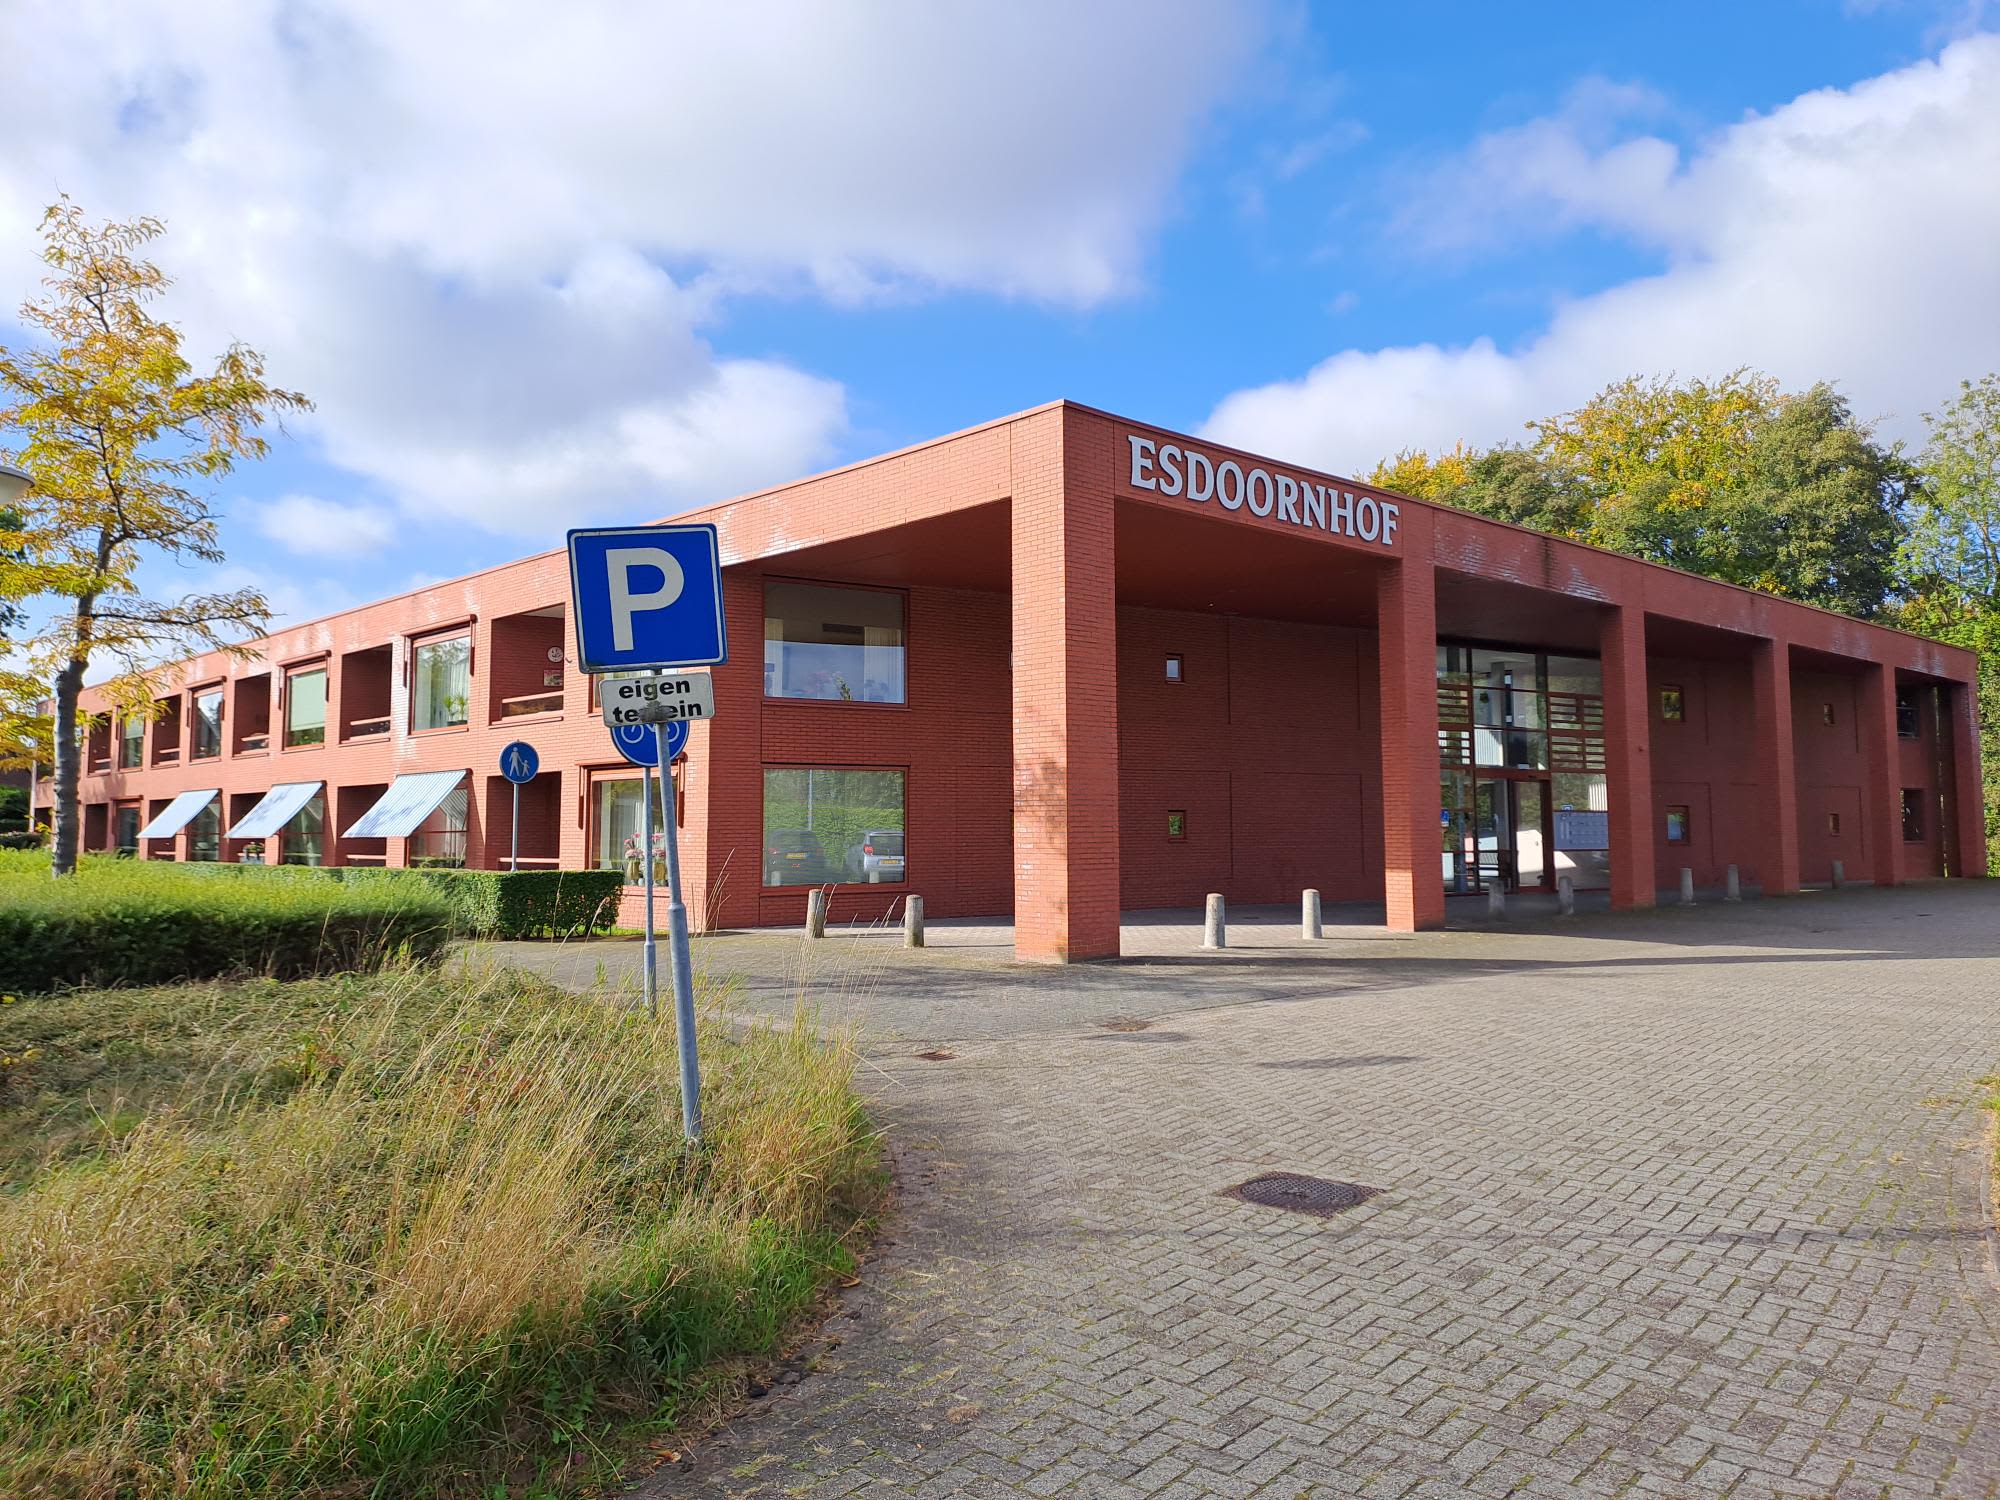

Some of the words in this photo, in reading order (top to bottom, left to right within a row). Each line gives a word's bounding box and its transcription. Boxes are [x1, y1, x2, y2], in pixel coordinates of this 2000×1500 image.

[1128, 435, 1400, 545] ESDOORNHOF
[606, 547, 685, 652] P
[612, 700, 702, 723] teein
[619, 680, 691, 701] eigen
